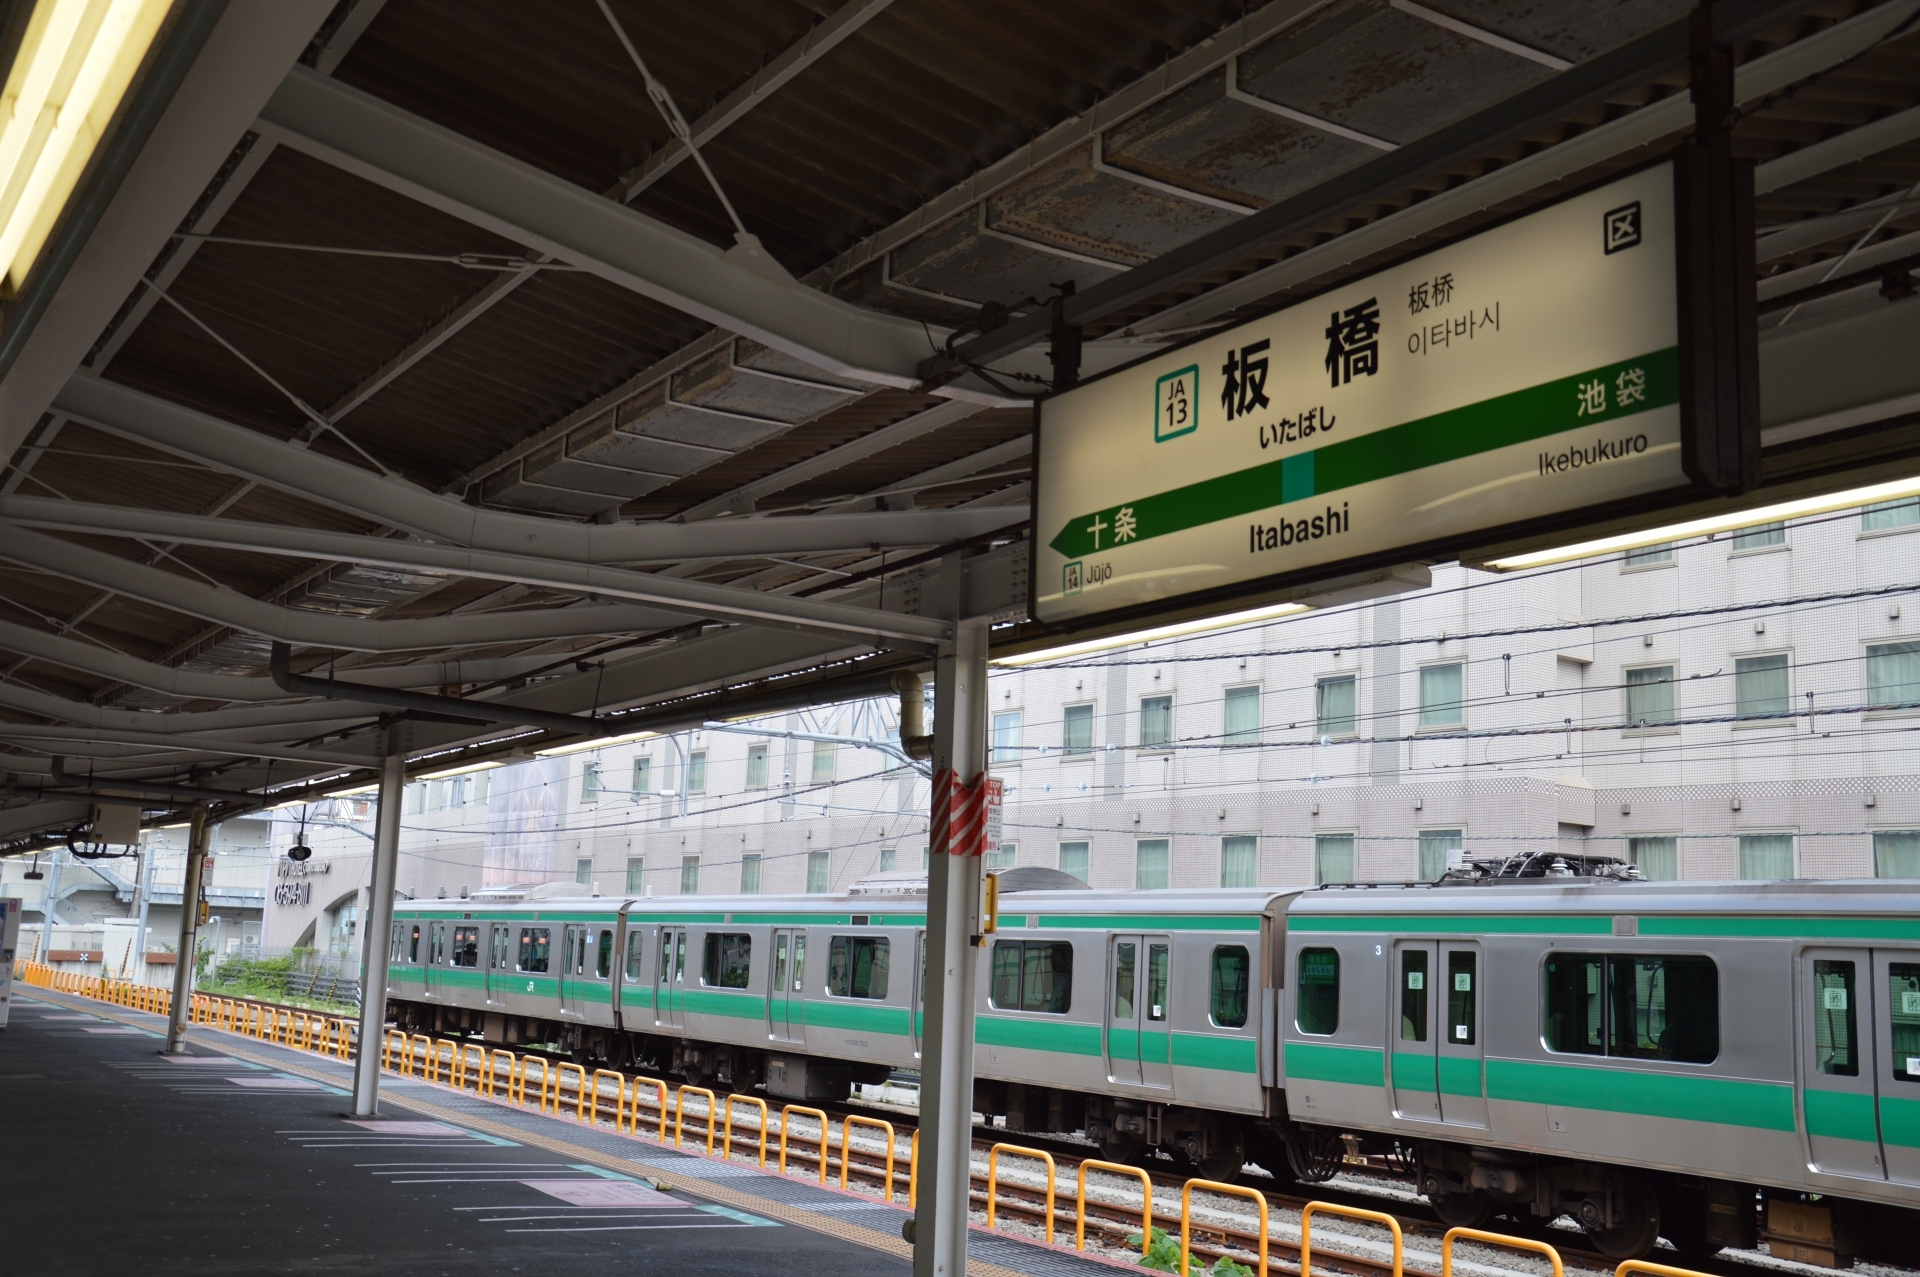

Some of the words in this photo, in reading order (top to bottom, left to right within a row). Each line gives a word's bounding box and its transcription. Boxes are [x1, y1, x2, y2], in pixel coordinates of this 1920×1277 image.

[1607, 206, 1638, 250] 区
[1408, 273, 1454, 315] 板桥
[1408, 301, 1499, 355] 이타바시
[1221, 295, 1380, 422] 板橋
[1168, 379, 1185, 400] JA
[1577, 367, 1646, 417] 池袋
[1166, 398, 1188, 427] 13
[1260, 405, 1336, 449] いたばし
[1539, 434, 1648, 476] Ikebukuro
[1086, 506, 1136, 550] 十条
[1250, 501, 1348, 553] Itabashi
[1068, 576, 1078, 590] 14
[1069, 566, 1077, 577] JA
[1086, 562, 1112, 585] Jūjō
[1375, 944, 1382, 956] 3
